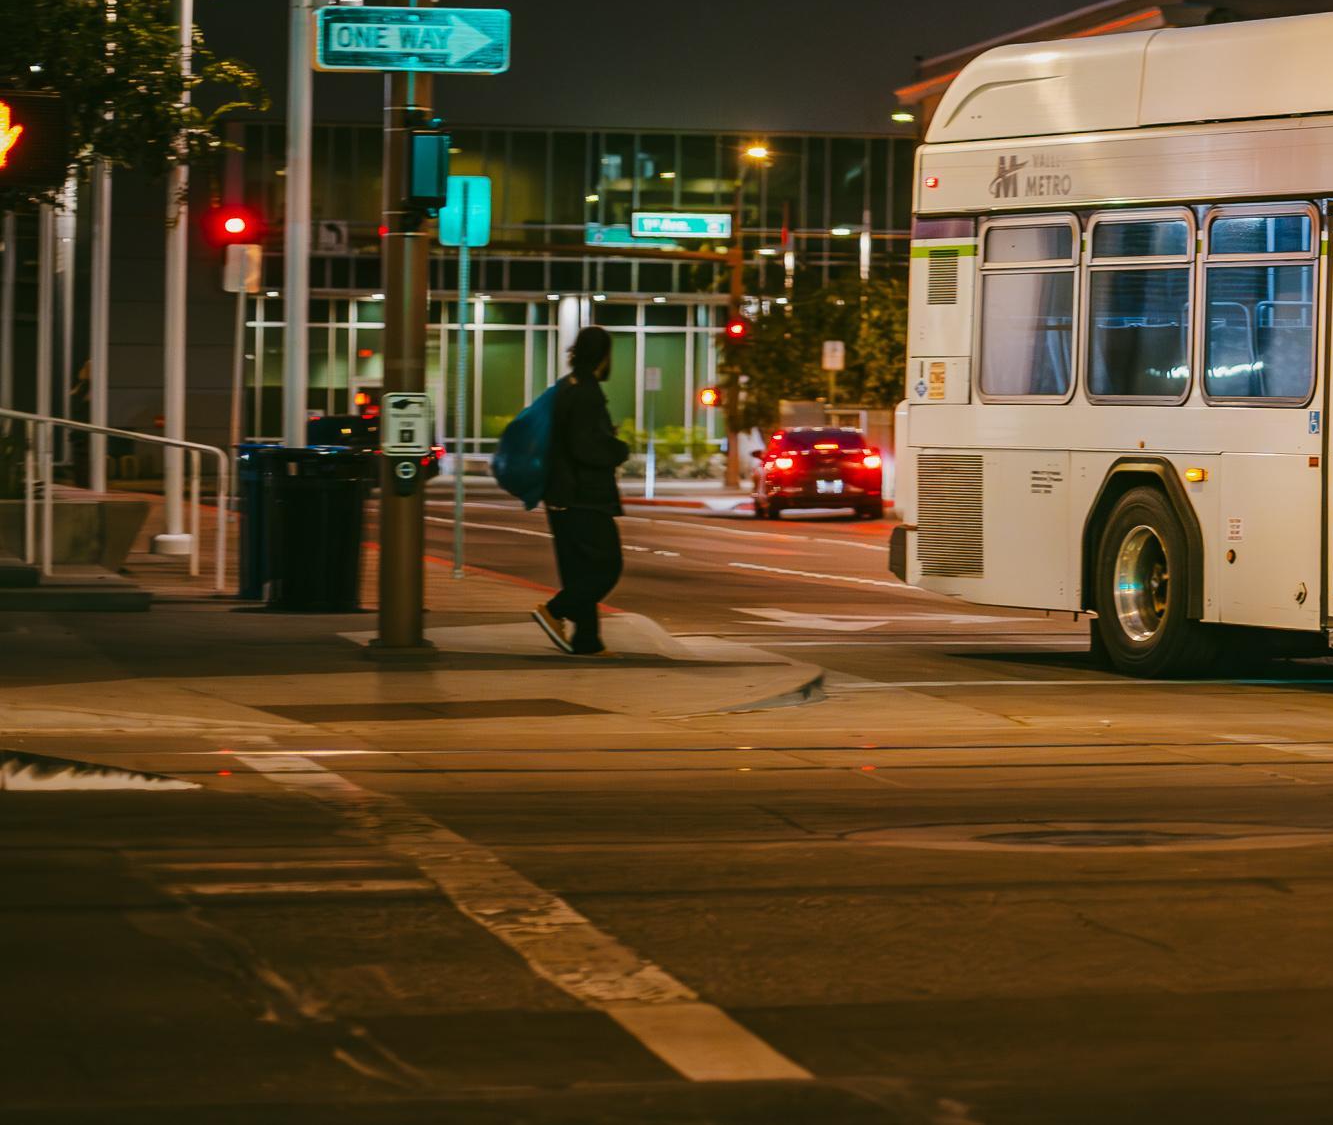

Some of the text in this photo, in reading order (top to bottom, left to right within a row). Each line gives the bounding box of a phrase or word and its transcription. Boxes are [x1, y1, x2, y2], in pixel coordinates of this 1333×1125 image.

[336, 26, 449, 50] ONE WAY
[1025, 174, 1072, 197] METRO
